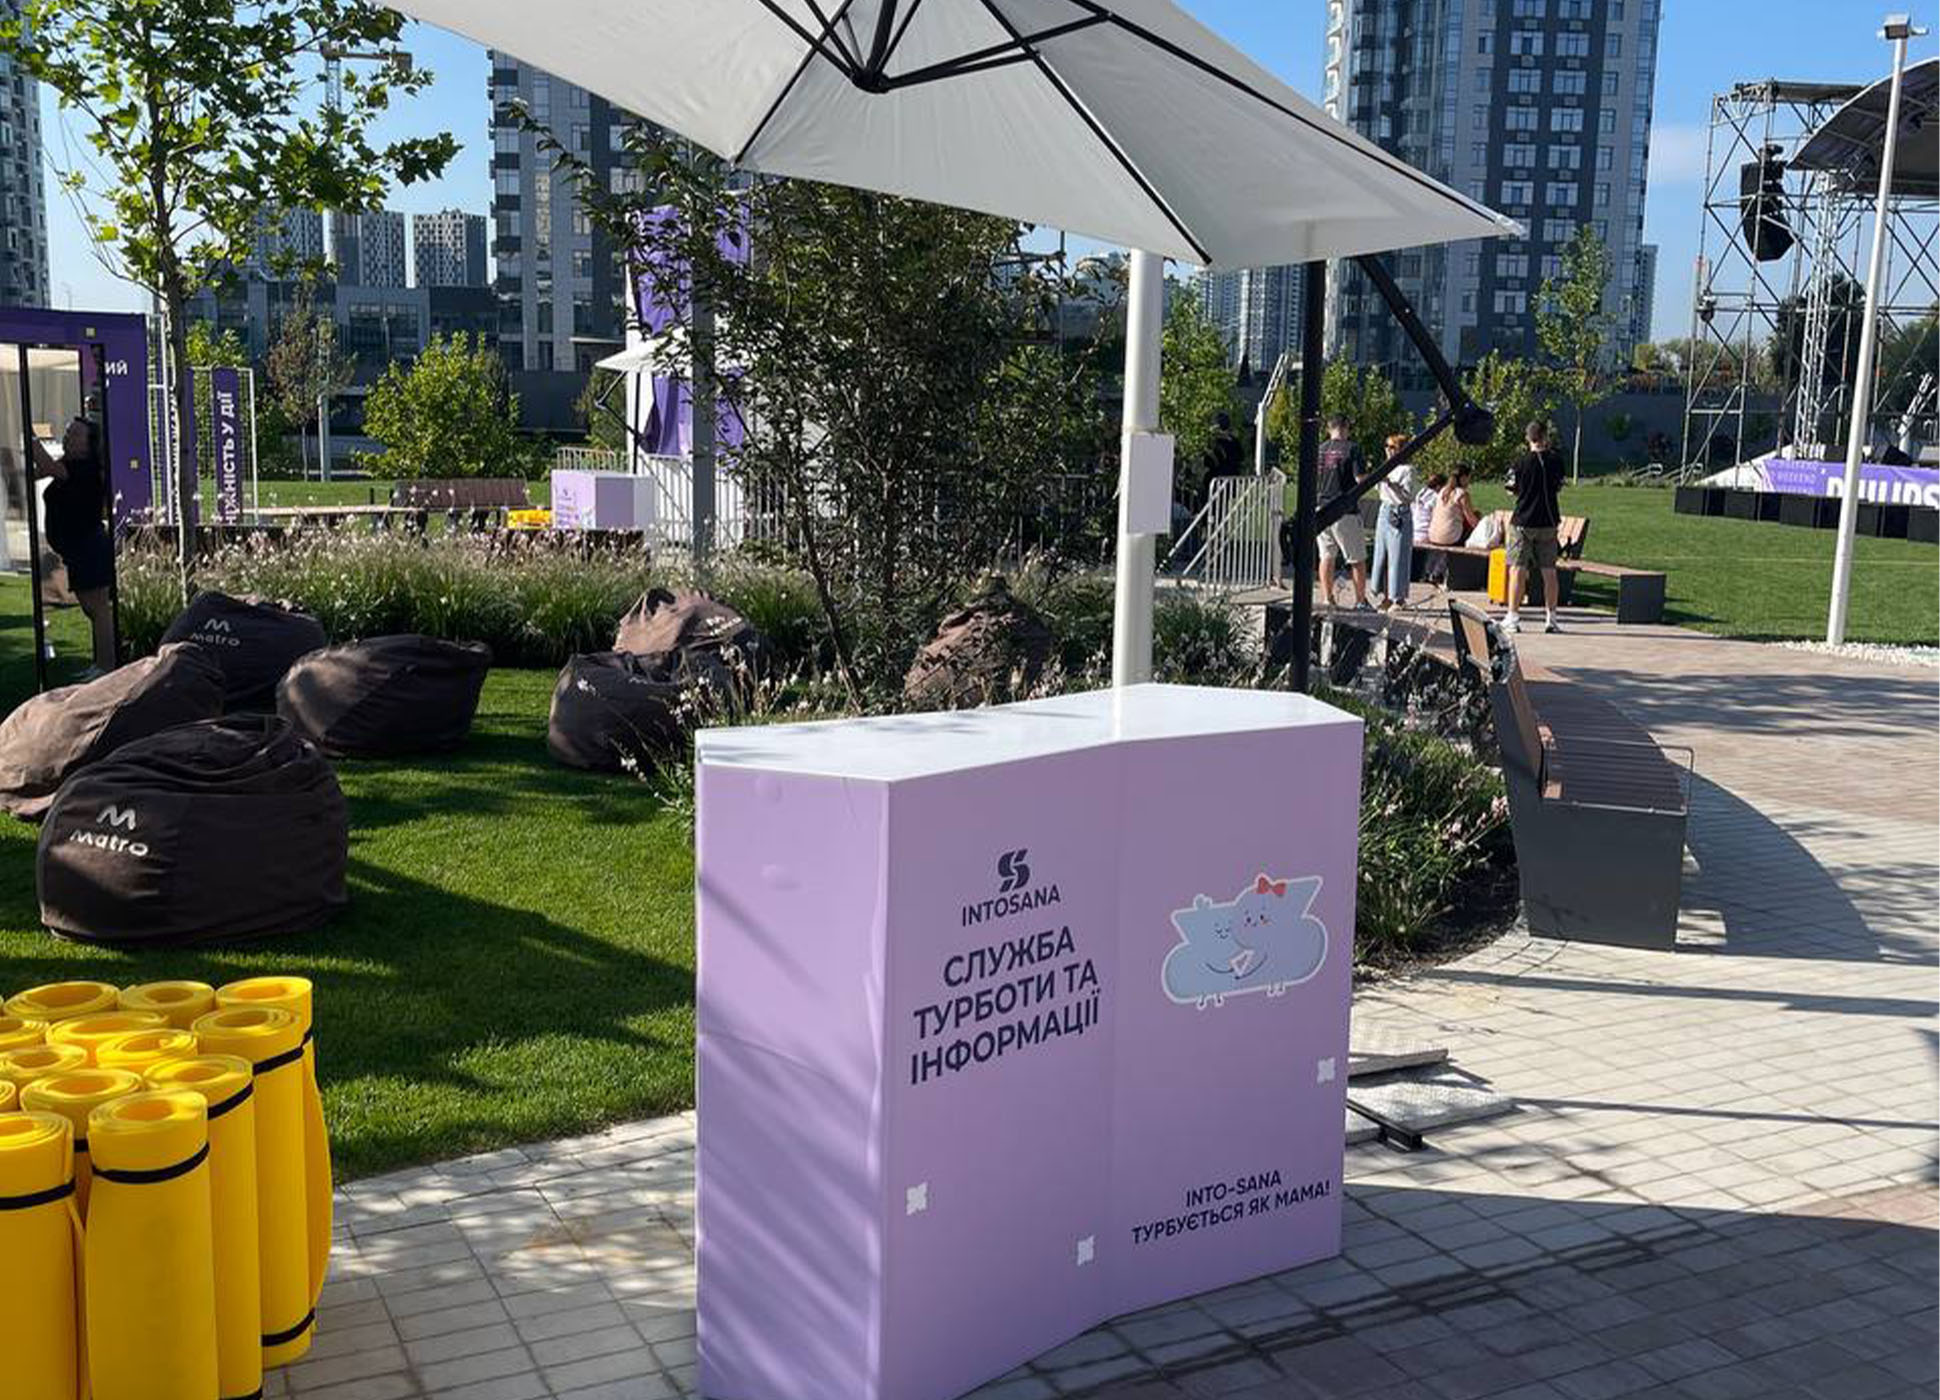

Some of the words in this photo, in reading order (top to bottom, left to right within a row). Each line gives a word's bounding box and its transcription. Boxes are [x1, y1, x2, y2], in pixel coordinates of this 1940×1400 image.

[221, 421, 235, 435] У
[962, 884, 1061, 927] INTOSANA
[943, 925, 1075, 988] СЛУЖБА
[913, 970, 1056, 1040] ТУРБОТИ
[1063, 958, 1098, 994] ТА
[911, 988, 1101, 1085] ІНФОРМАЦІЇ
[1131, 1202, 1245, 1245] ТУРБУЄТЬСЯ
[1248, 1195, 1271, 1216] ЯК
[1274, 1179, 1331, 1209] МАМА!
[1186, 1169, 1282, 1208] INTO-SANA
